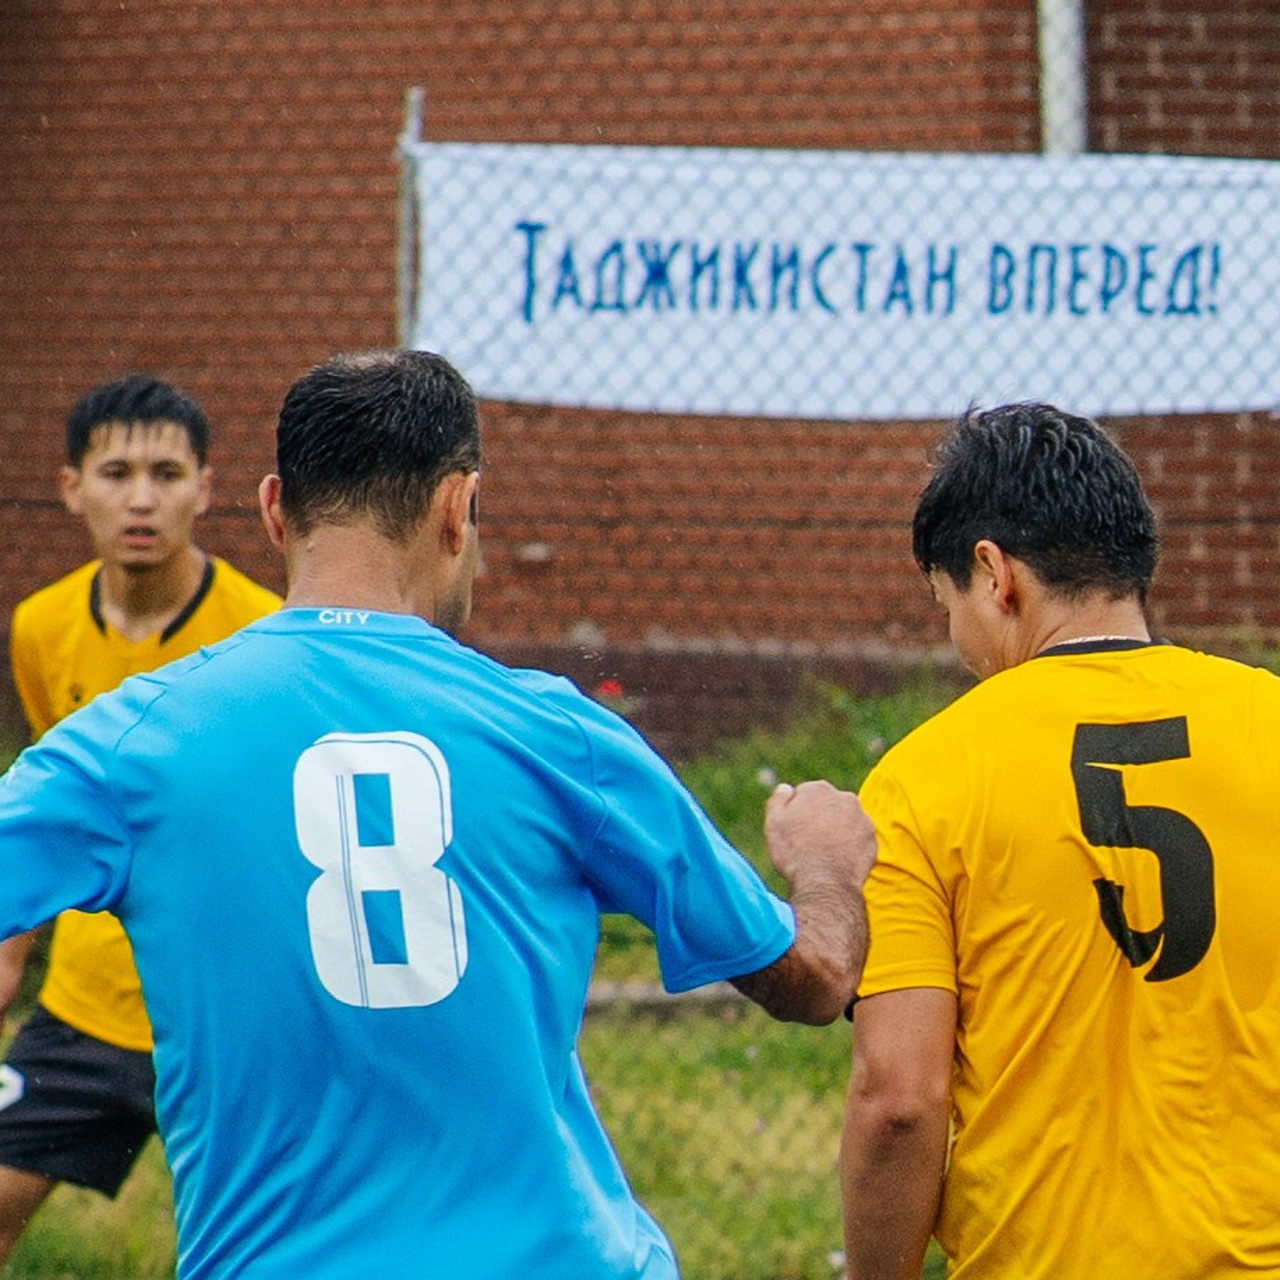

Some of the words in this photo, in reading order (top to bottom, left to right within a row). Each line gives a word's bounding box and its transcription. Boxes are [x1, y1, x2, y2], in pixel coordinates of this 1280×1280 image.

[318, 609, 370, 626] CITY
[292, 730, 468, 1010] 8
[1070, 715, 1217, 982] 5
